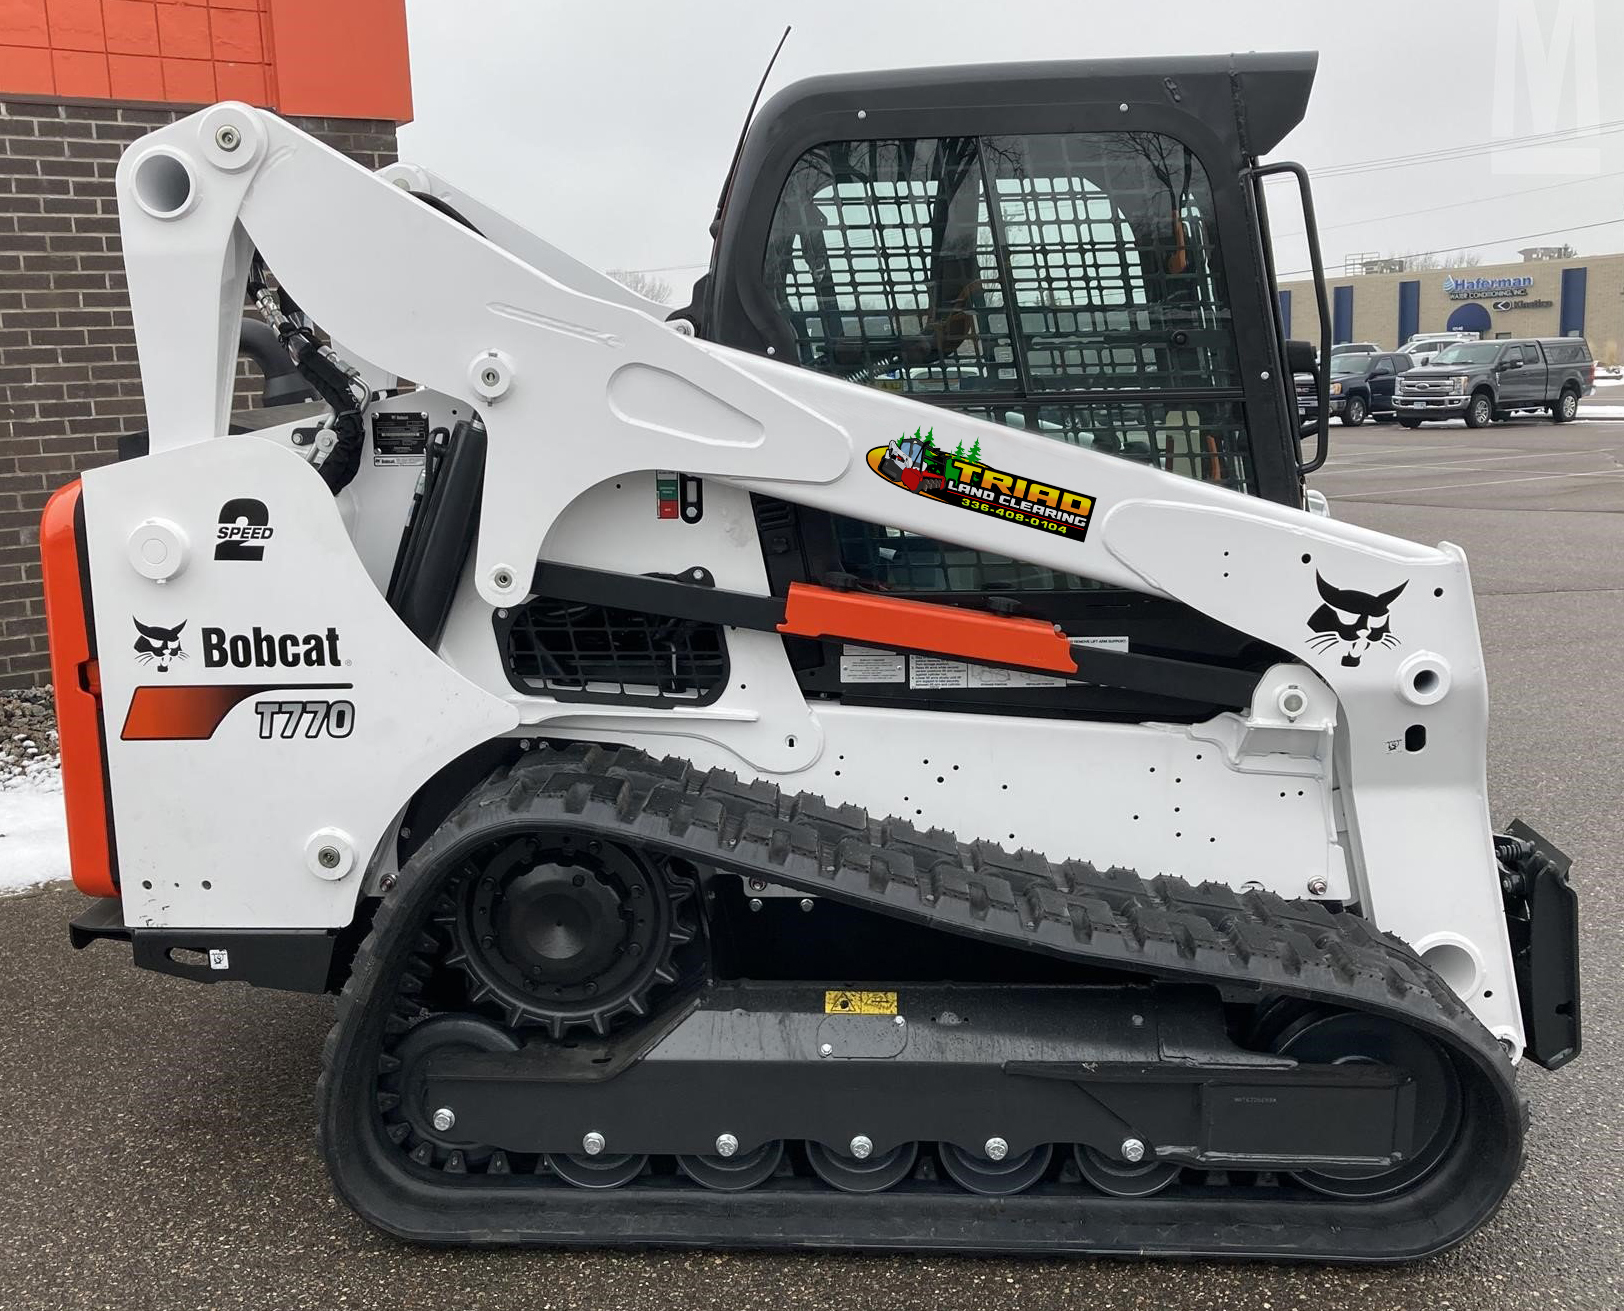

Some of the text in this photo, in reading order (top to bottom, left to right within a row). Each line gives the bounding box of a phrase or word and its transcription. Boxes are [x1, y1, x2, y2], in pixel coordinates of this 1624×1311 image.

[1454, 277, 1533, 290] Haferman
[948, 480, 1087, 527] LAND CLEARING
[953, 460, 1092, 516] TRIAD
[214, 497, 270, 561] 2
[217, 526, 274, 539] SPEED
[961, 497, 1067, 534] 336-408-0104
[201, 626, 342, 668] Bobcat
[255, 700, 356, 739] T770
